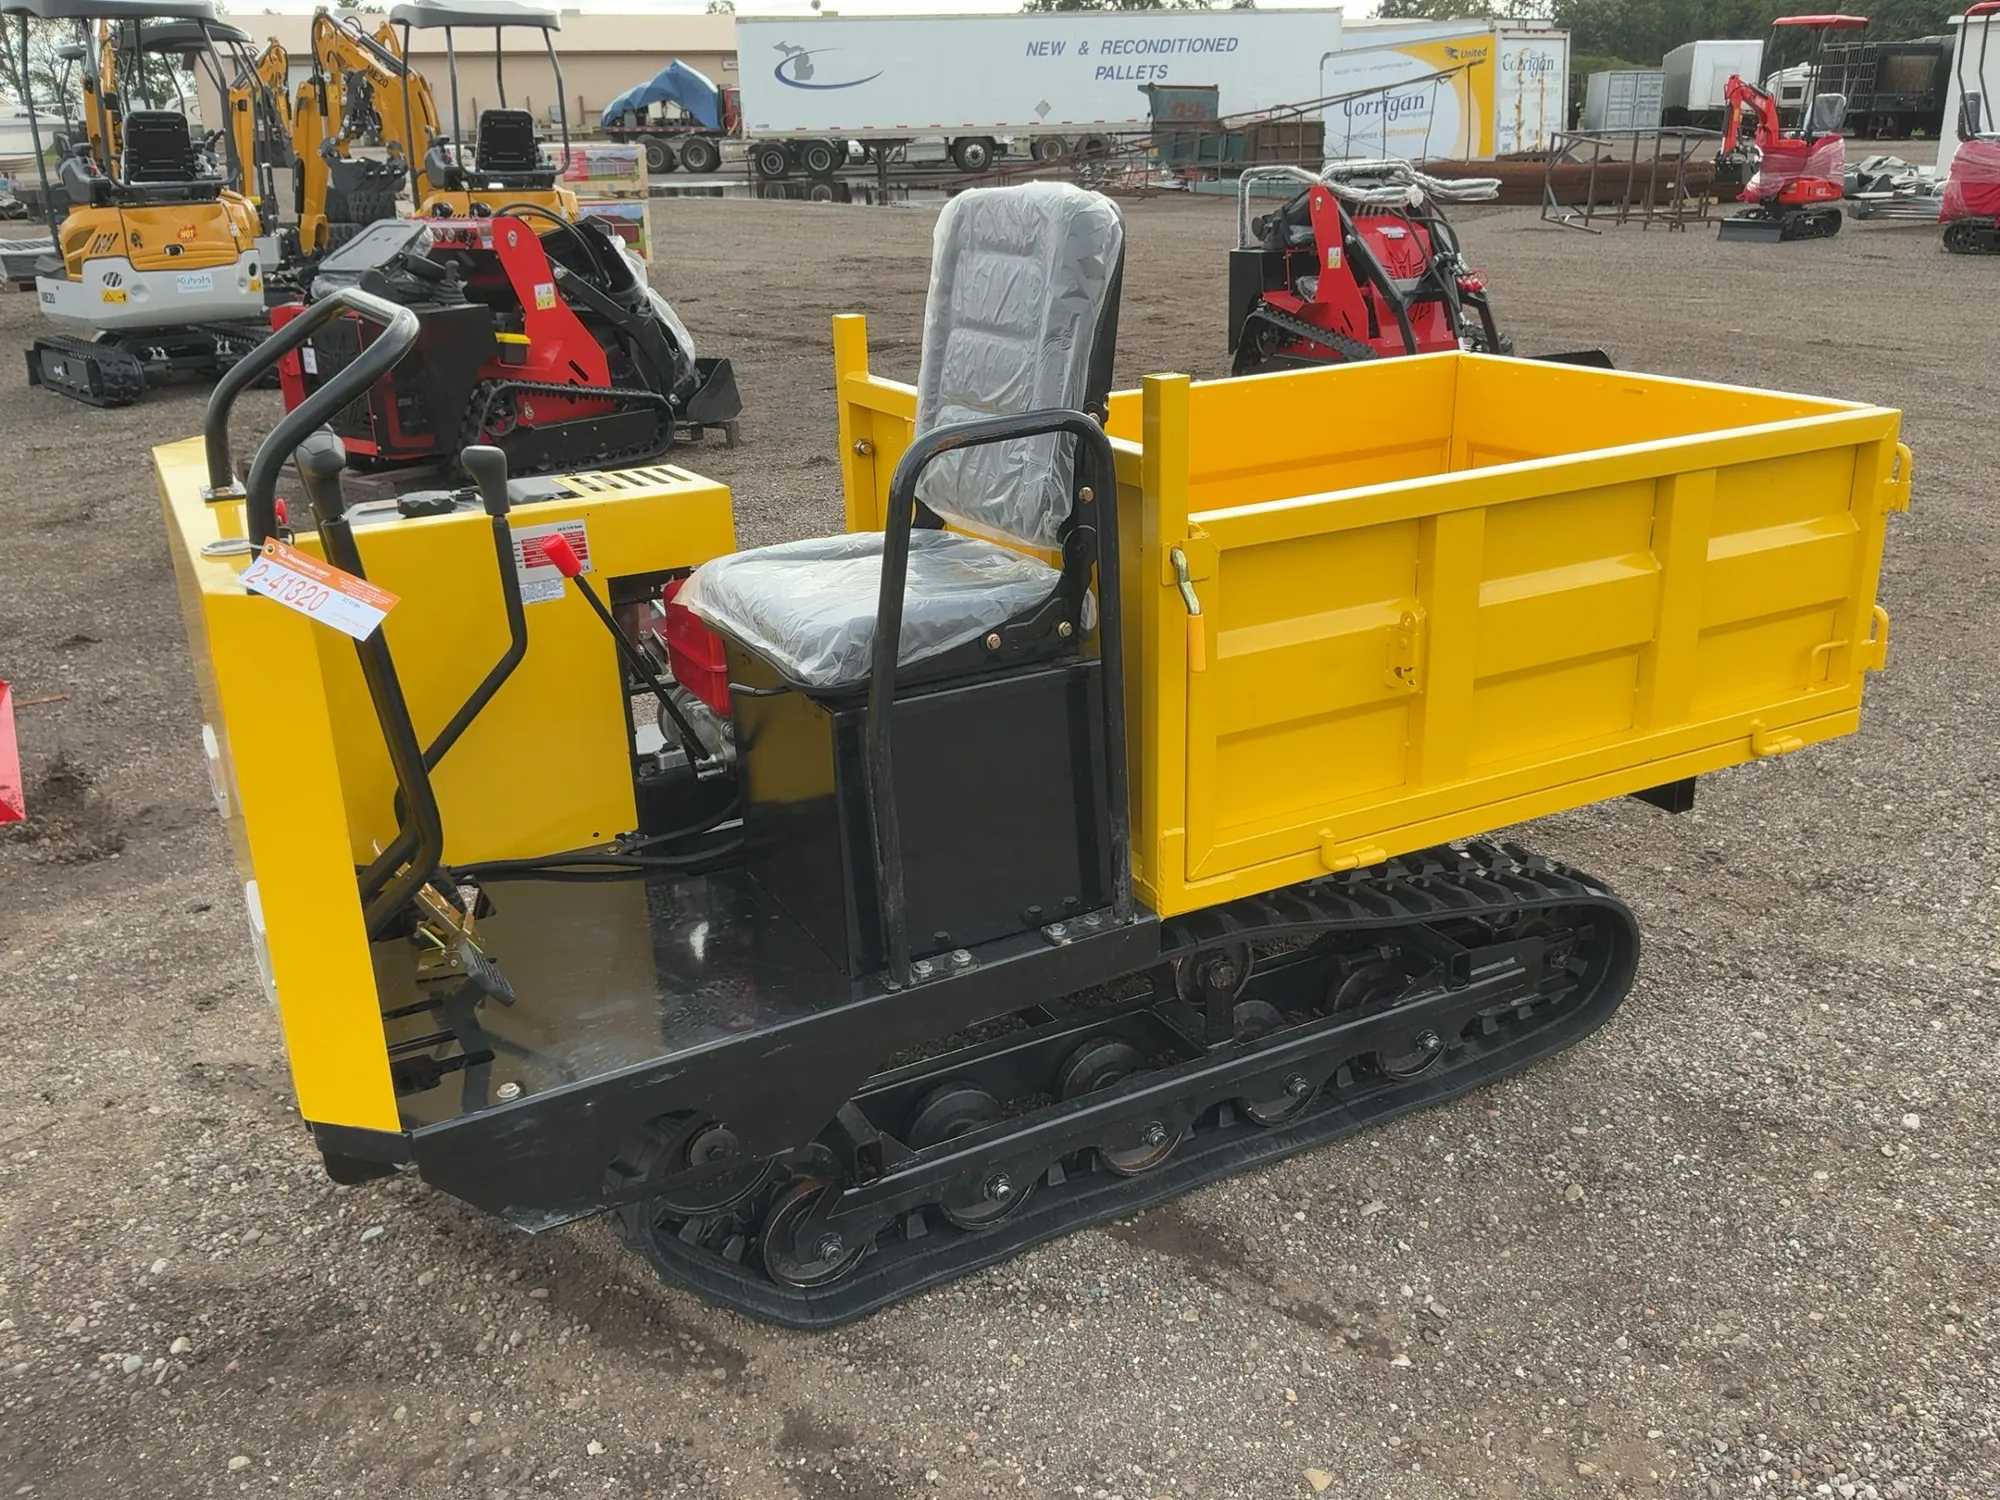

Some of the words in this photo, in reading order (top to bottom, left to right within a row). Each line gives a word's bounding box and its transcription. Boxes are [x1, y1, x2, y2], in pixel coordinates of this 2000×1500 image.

[1026, 41, 1066, 56] NEW
[1078, 41, 1090, 55] &
[1100, 37, 1239, 55] RECONDITIONED
[1461, 46, 1488, 59] United
[1095, 64, 1169, 80] PALLETS
[1343, 91, 1425, 121] Corrigan
[180, 229, 194, 239] HOT
[245, 563, 330, 612] 2-41320
